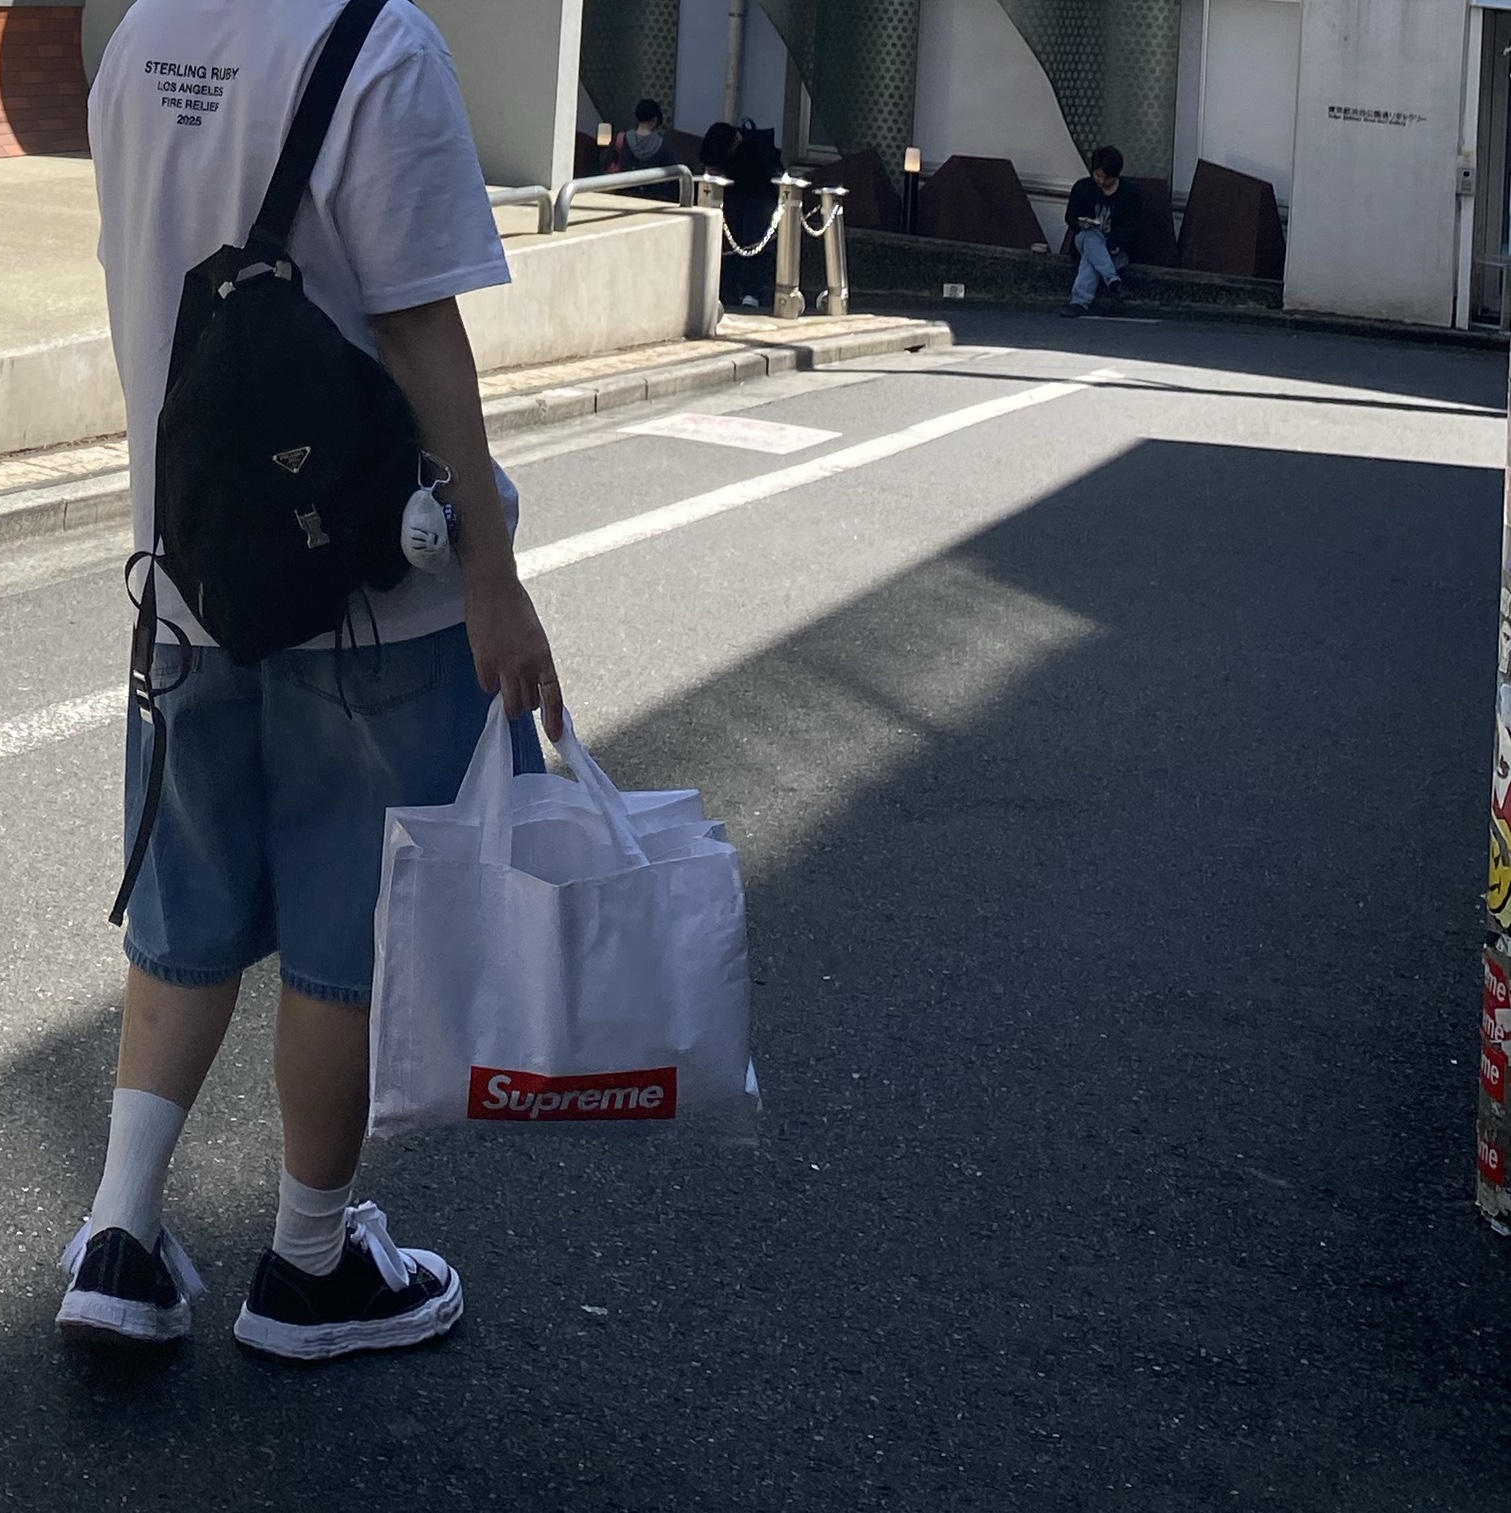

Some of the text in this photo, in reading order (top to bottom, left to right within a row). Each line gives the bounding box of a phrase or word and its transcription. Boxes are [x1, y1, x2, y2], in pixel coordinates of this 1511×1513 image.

[144, 61, 239, 81] STERLING RUBY
[157, 81, 223, 97] LOS ANGELES
[161, 97, 219, 112] FIRE RELIEF
[177, 114, 202, 126] 2025
[482, 1074, 664, 1119] Supreme
